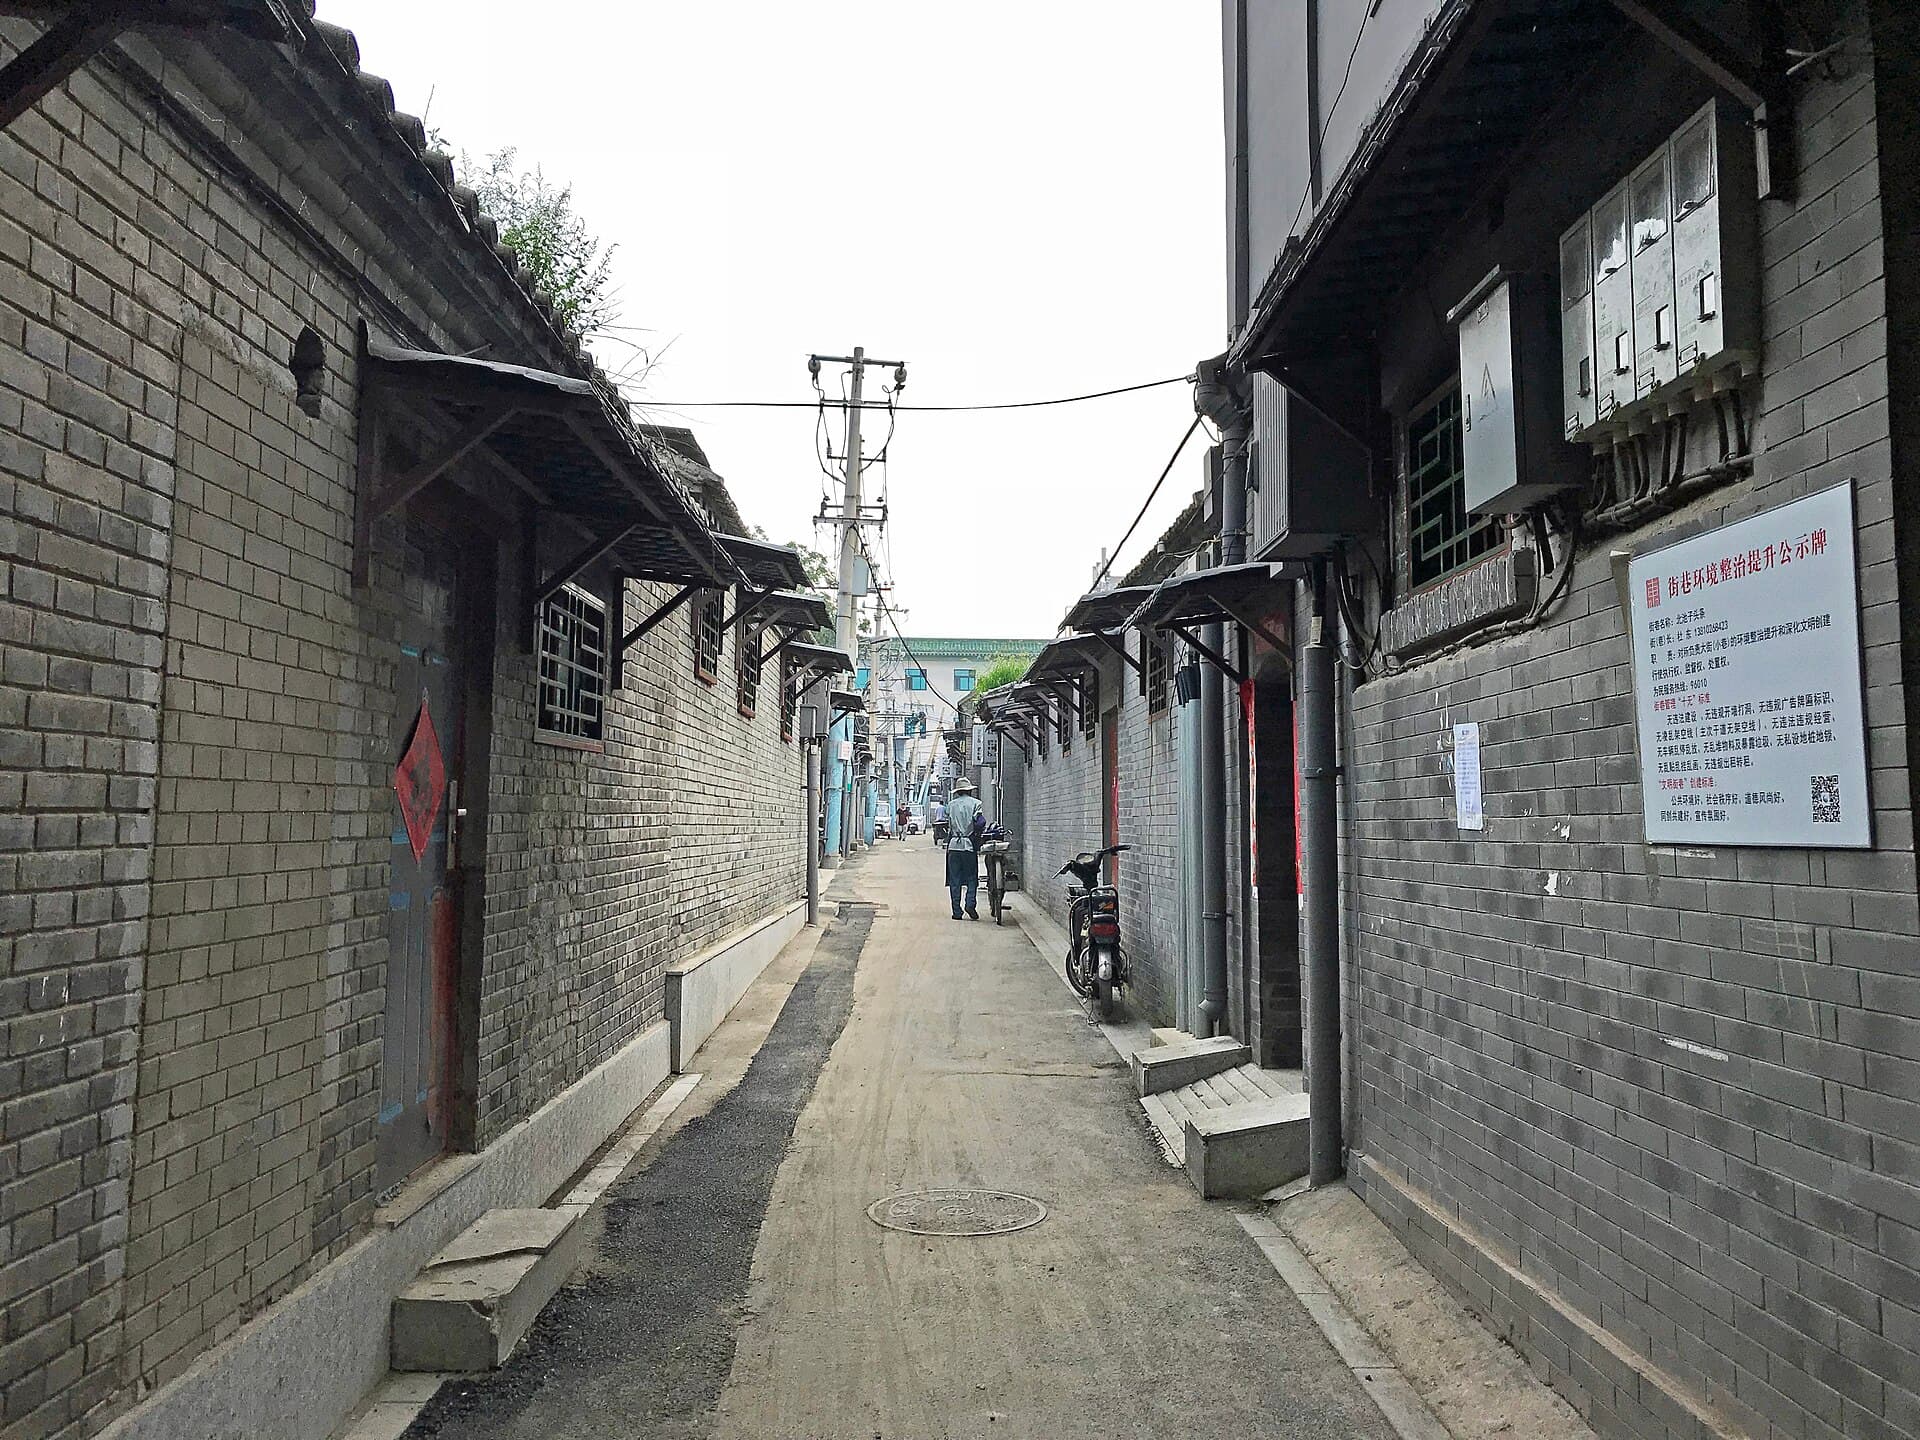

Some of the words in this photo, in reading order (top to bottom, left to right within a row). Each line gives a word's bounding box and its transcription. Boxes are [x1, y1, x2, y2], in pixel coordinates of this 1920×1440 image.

[1668, 528, 1828, 599] 街巷环境整治提升公示牌
